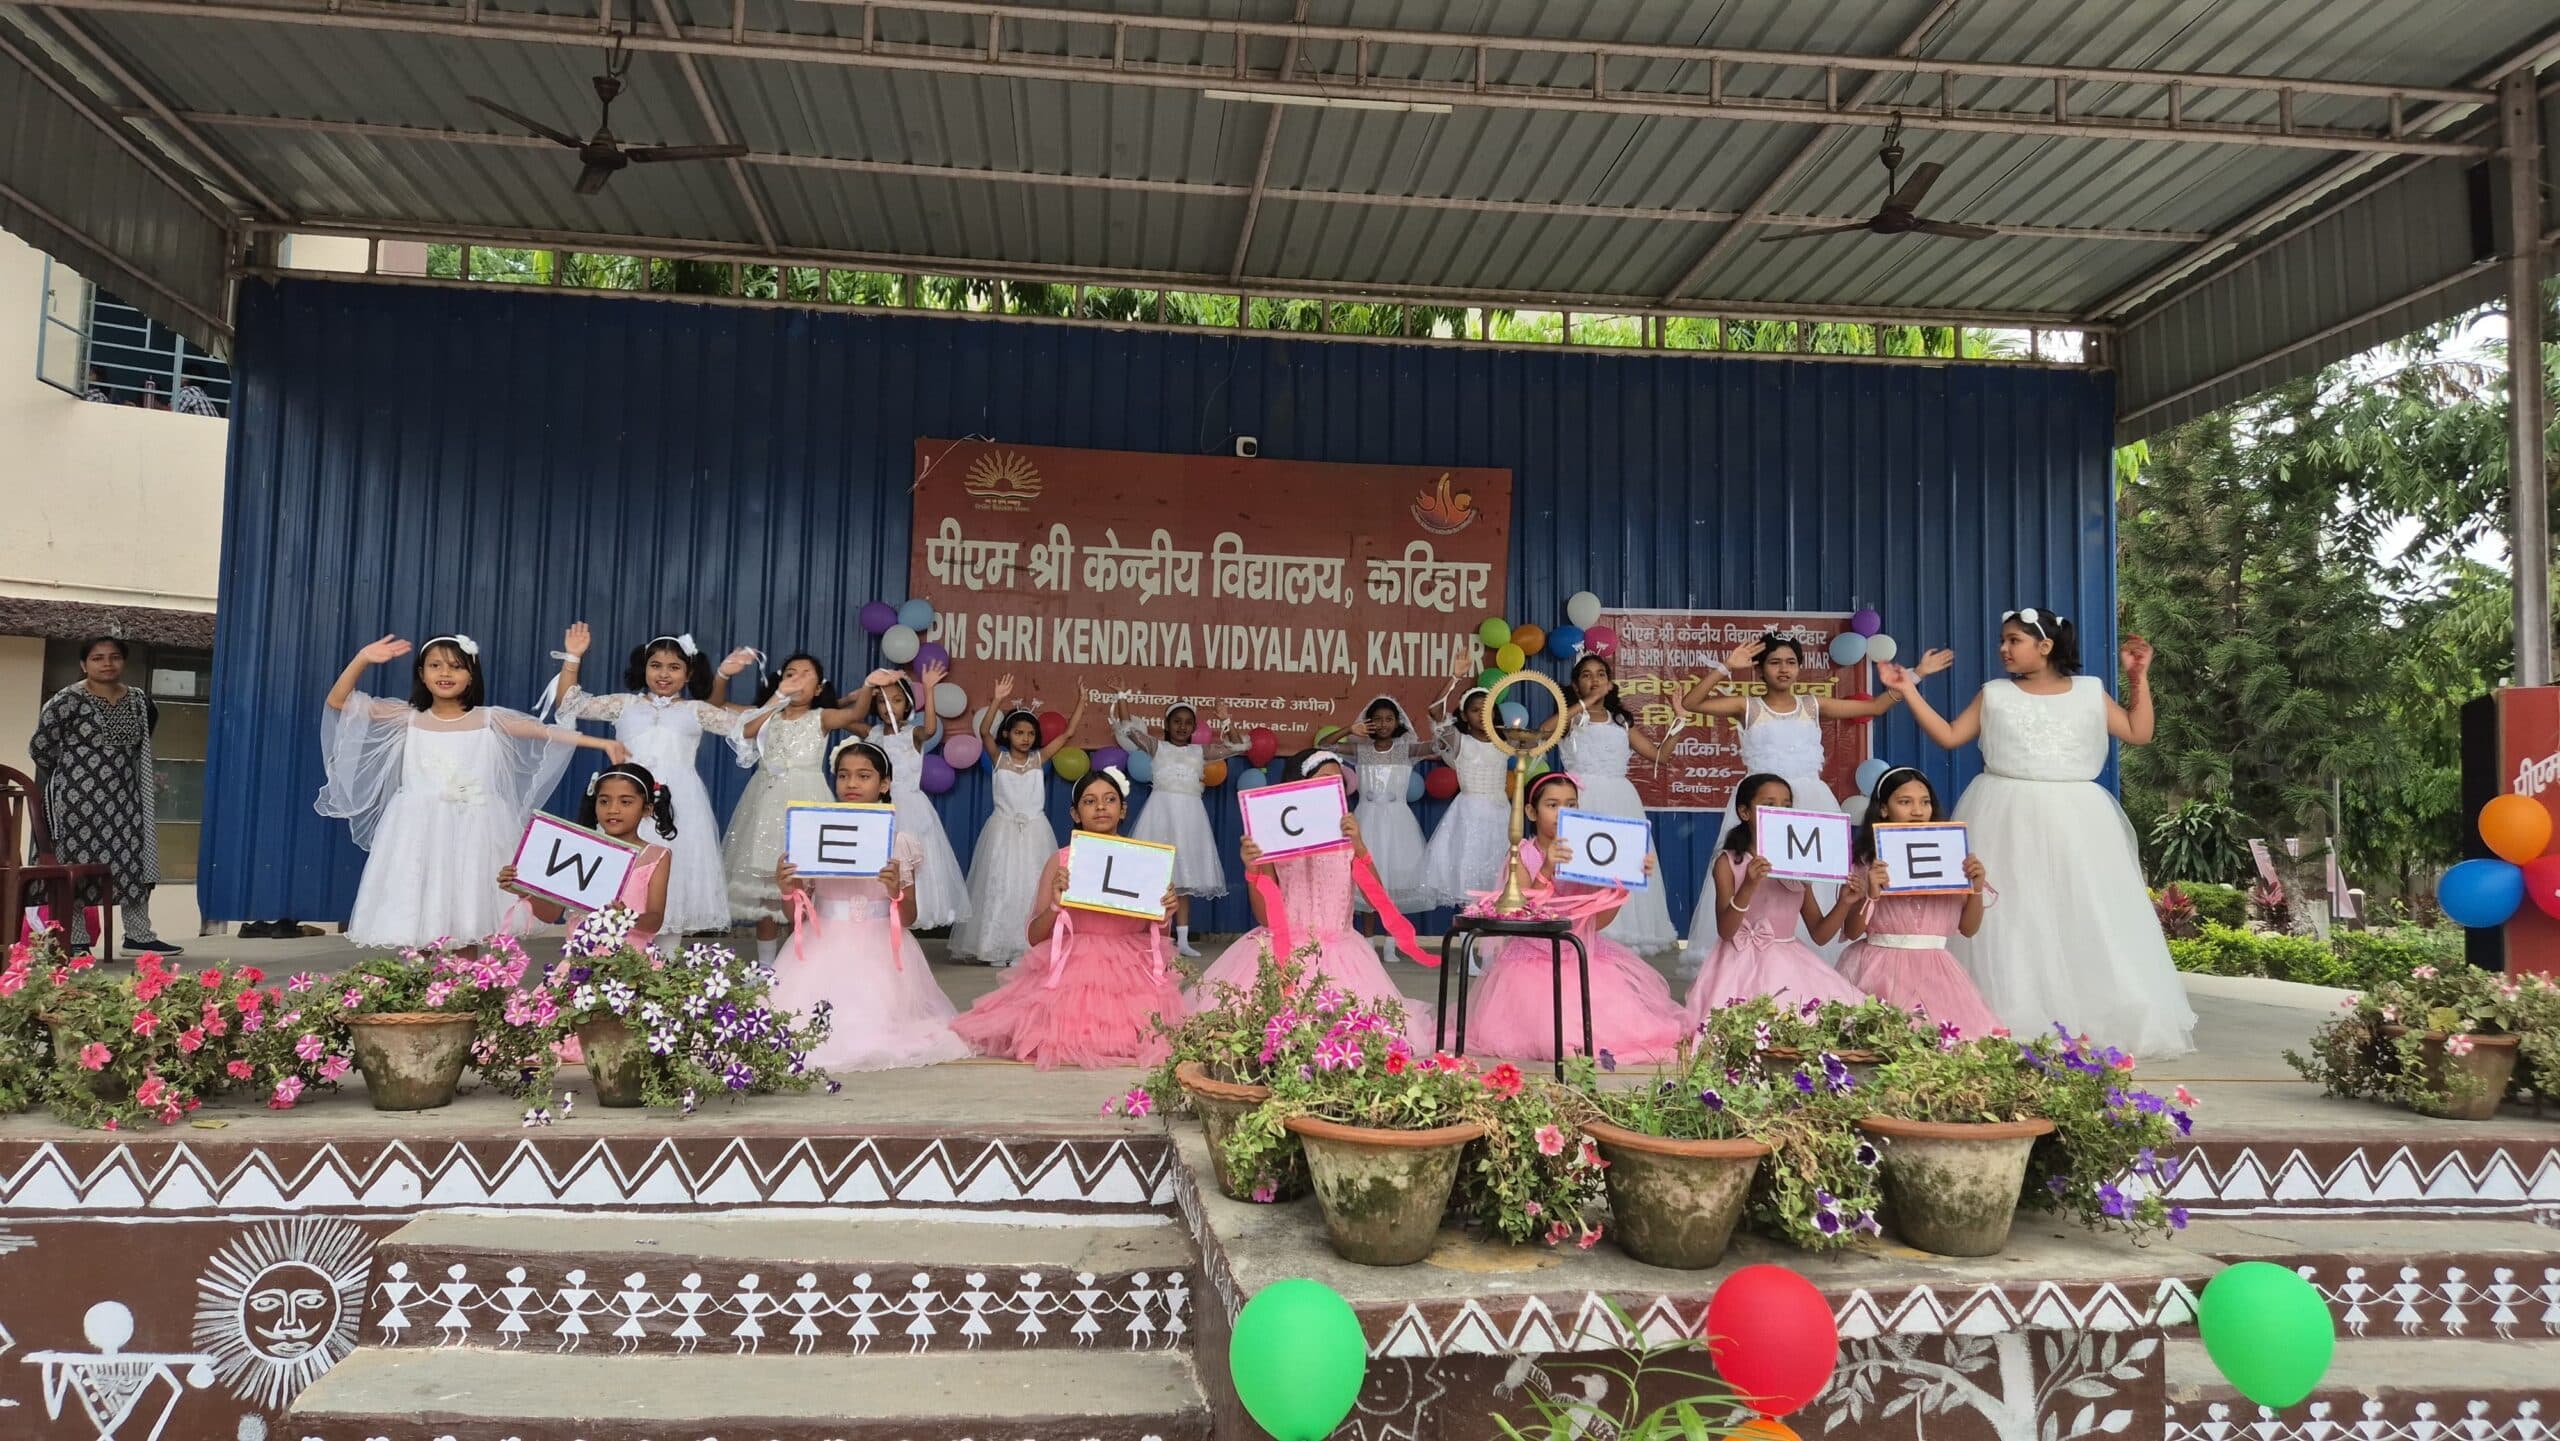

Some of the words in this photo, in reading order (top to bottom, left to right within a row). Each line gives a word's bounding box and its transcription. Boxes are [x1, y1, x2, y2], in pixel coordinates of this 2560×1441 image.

[926, 517, 1019, 591] पीएम
[1028, 523, 1075, 591] श्री
[1083, 528, 1203, 606] केन्द्रीय
[1211, 532, 1354, 609] विद्यालय,
[1366, 540, 1491, 613] कटिहार
[926, 612, 967, 659] PM
[976, 614, 1043, 662] SHRI
[1053, 617, 1194, 669] KENDRIYA
[1203, 624, 1358, 686] VIDYALAYA,
[1368, 631, 1486, 679] KATIHAR
[1678, 623, 1721, 645] केन्द्रीय
[1621, 648, 1636, 667] PM
[1640, 649, 1664, 667] SHRI
[1271, 697, 1286, 710] के
[1280, 806, 1304, 837] C
[818, 824, 858, 865] E
[1586, 832, 1618, 866] O
[1787, 824, 1822, 862] M
[1906, 843, 1943, 879] E
[545, 838, 603, 892] W
[1102, 855, 1140, 899] L
